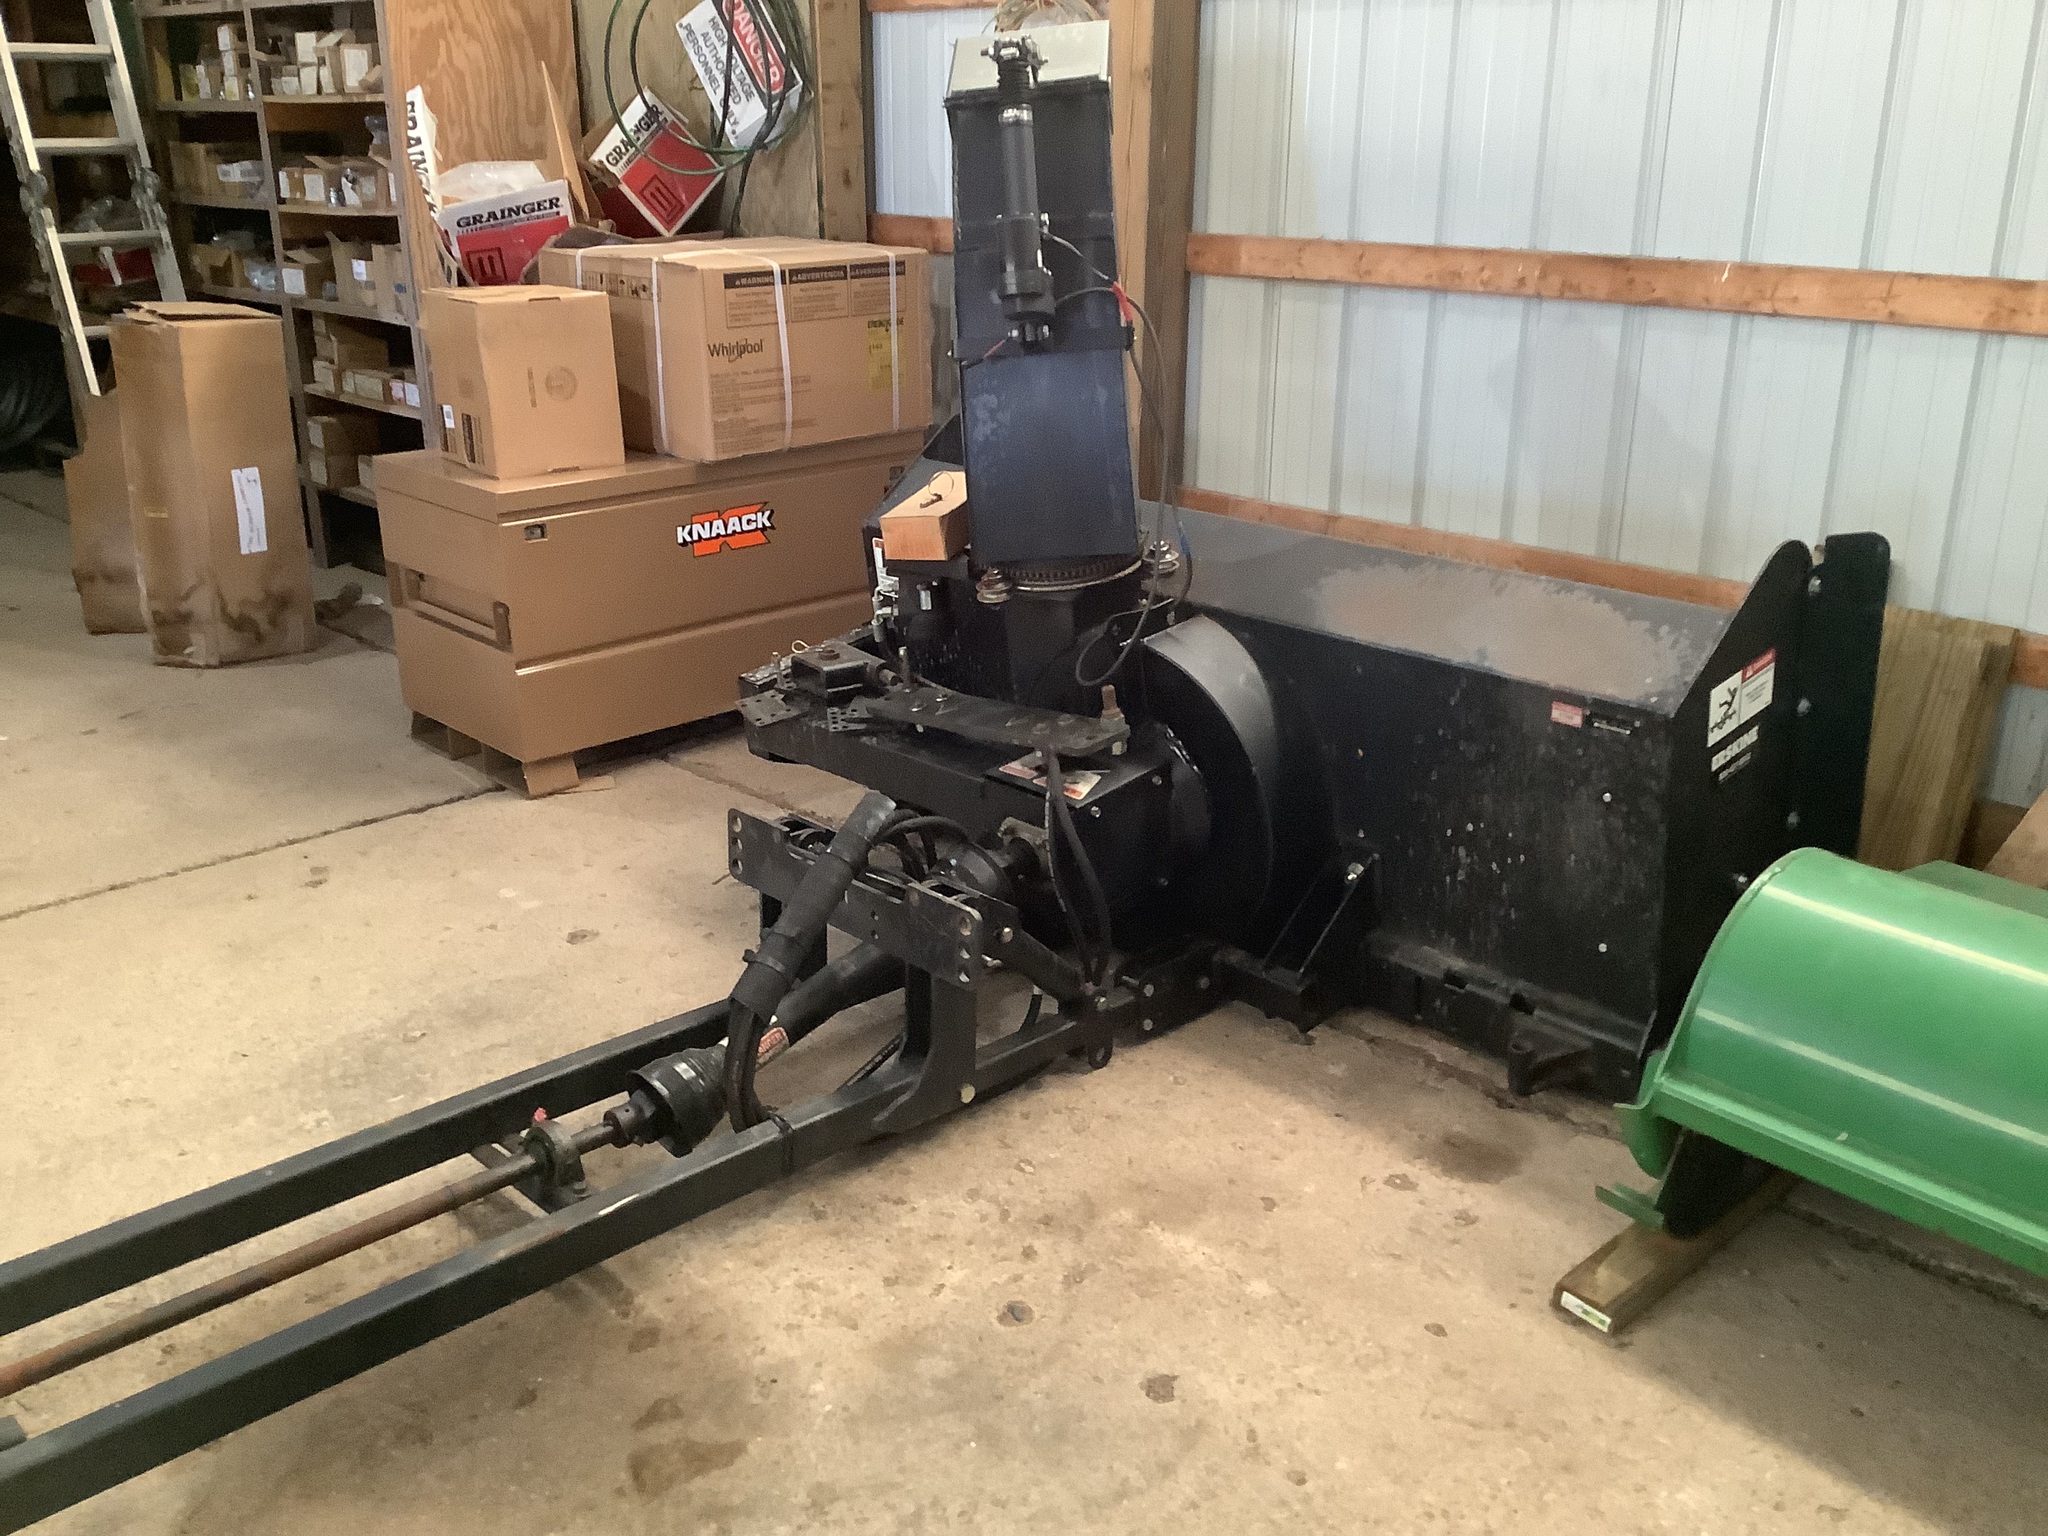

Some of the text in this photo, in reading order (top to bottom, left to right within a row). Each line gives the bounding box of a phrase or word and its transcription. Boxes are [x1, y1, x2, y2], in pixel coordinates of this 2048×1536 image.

[682, 22, 739, 126] PERSONNEL OLY
[701, 31, 741, 105] AUTHORZED
[708, 15, 756, 103] HIGH OLTAGE
[604, 103, 663, 168] GRANGER
[456, 197, 561, 228] GRAINGER
[707, 338, 765, 362] Whirlpool
[676, 510, 773, 544] KNAACK
